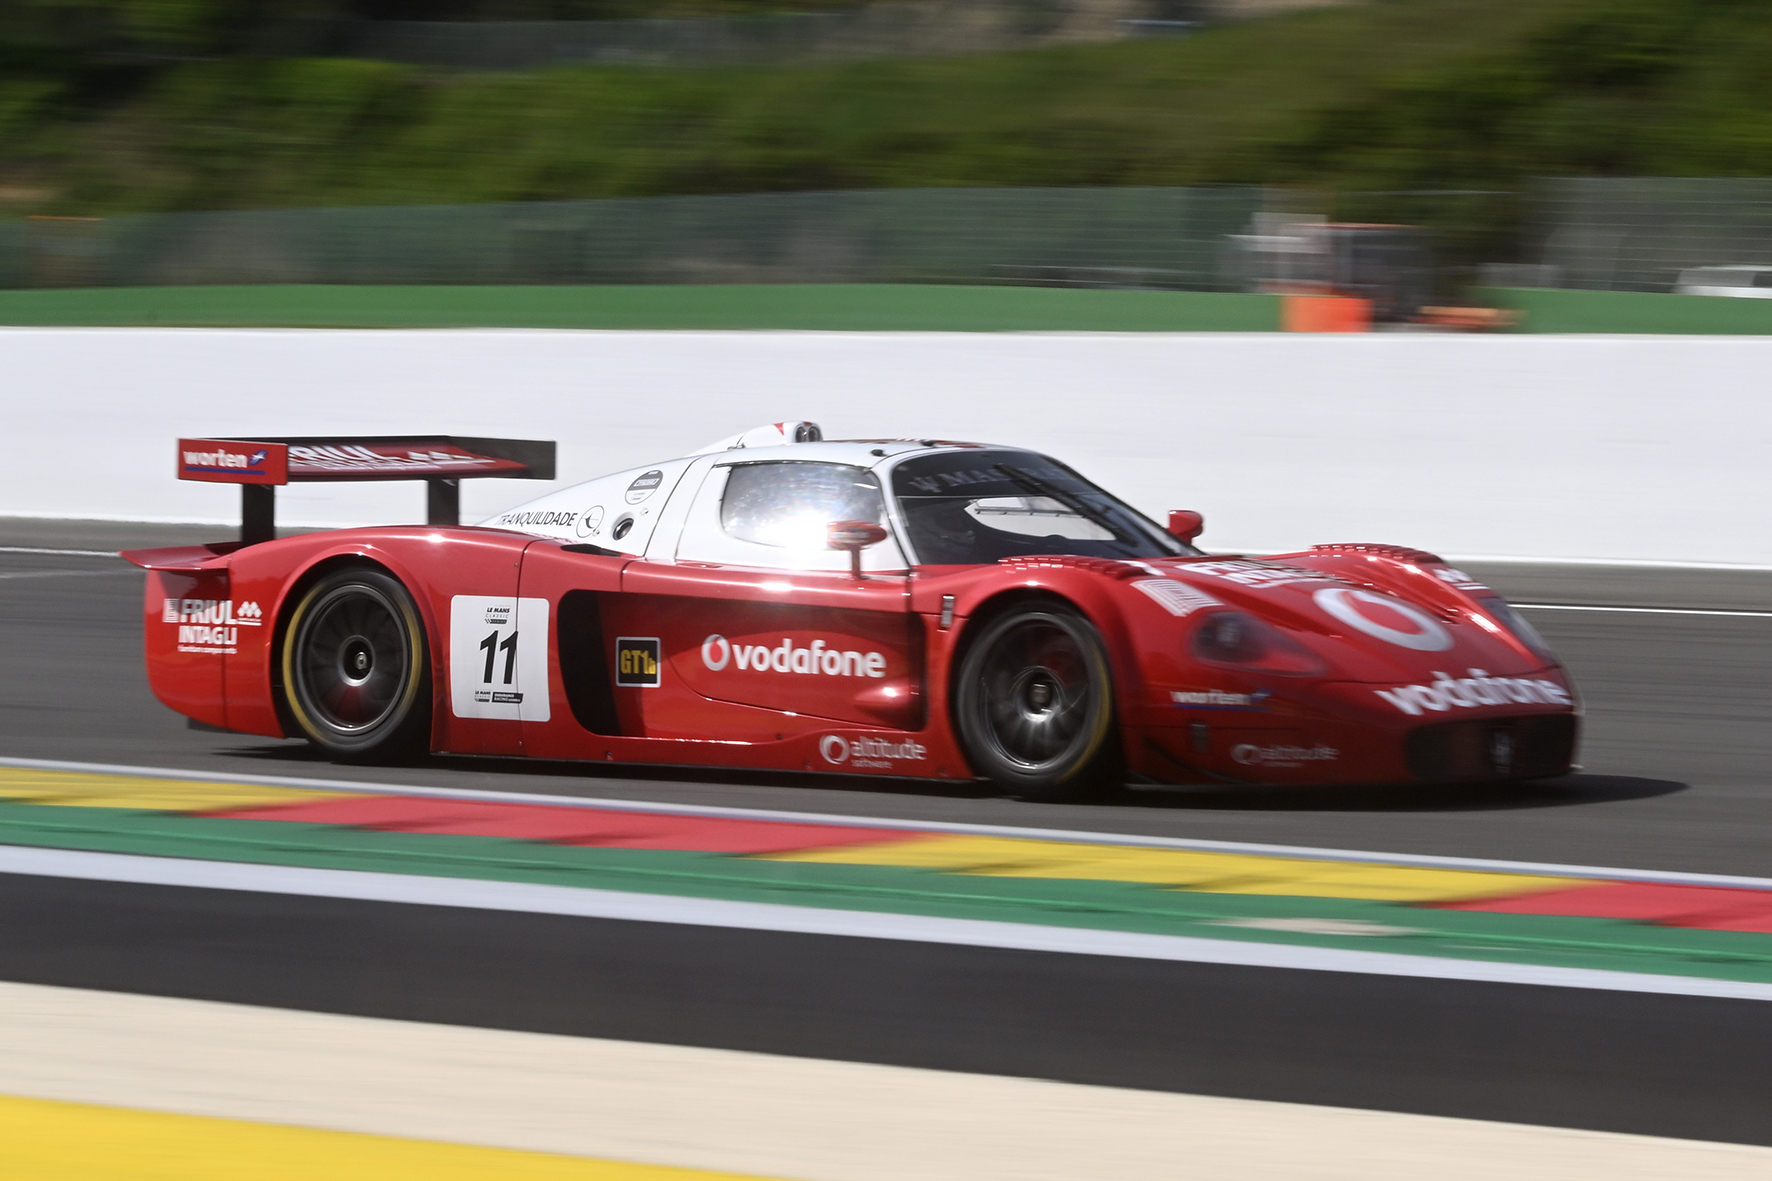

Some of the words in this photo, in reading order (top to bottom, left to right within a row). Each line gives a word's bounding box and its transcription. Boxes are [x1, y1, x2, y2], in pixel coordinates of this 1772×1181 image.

[183, 448, 248, 468] worten
[180, 598, 237, 625] FRIUL
[178, 625, 237, 645] INTAGLI
[480, 630, 519, 684] 11
[732, 638, 886, 678] vodafone
[850, 736, 927, 760] altitude
